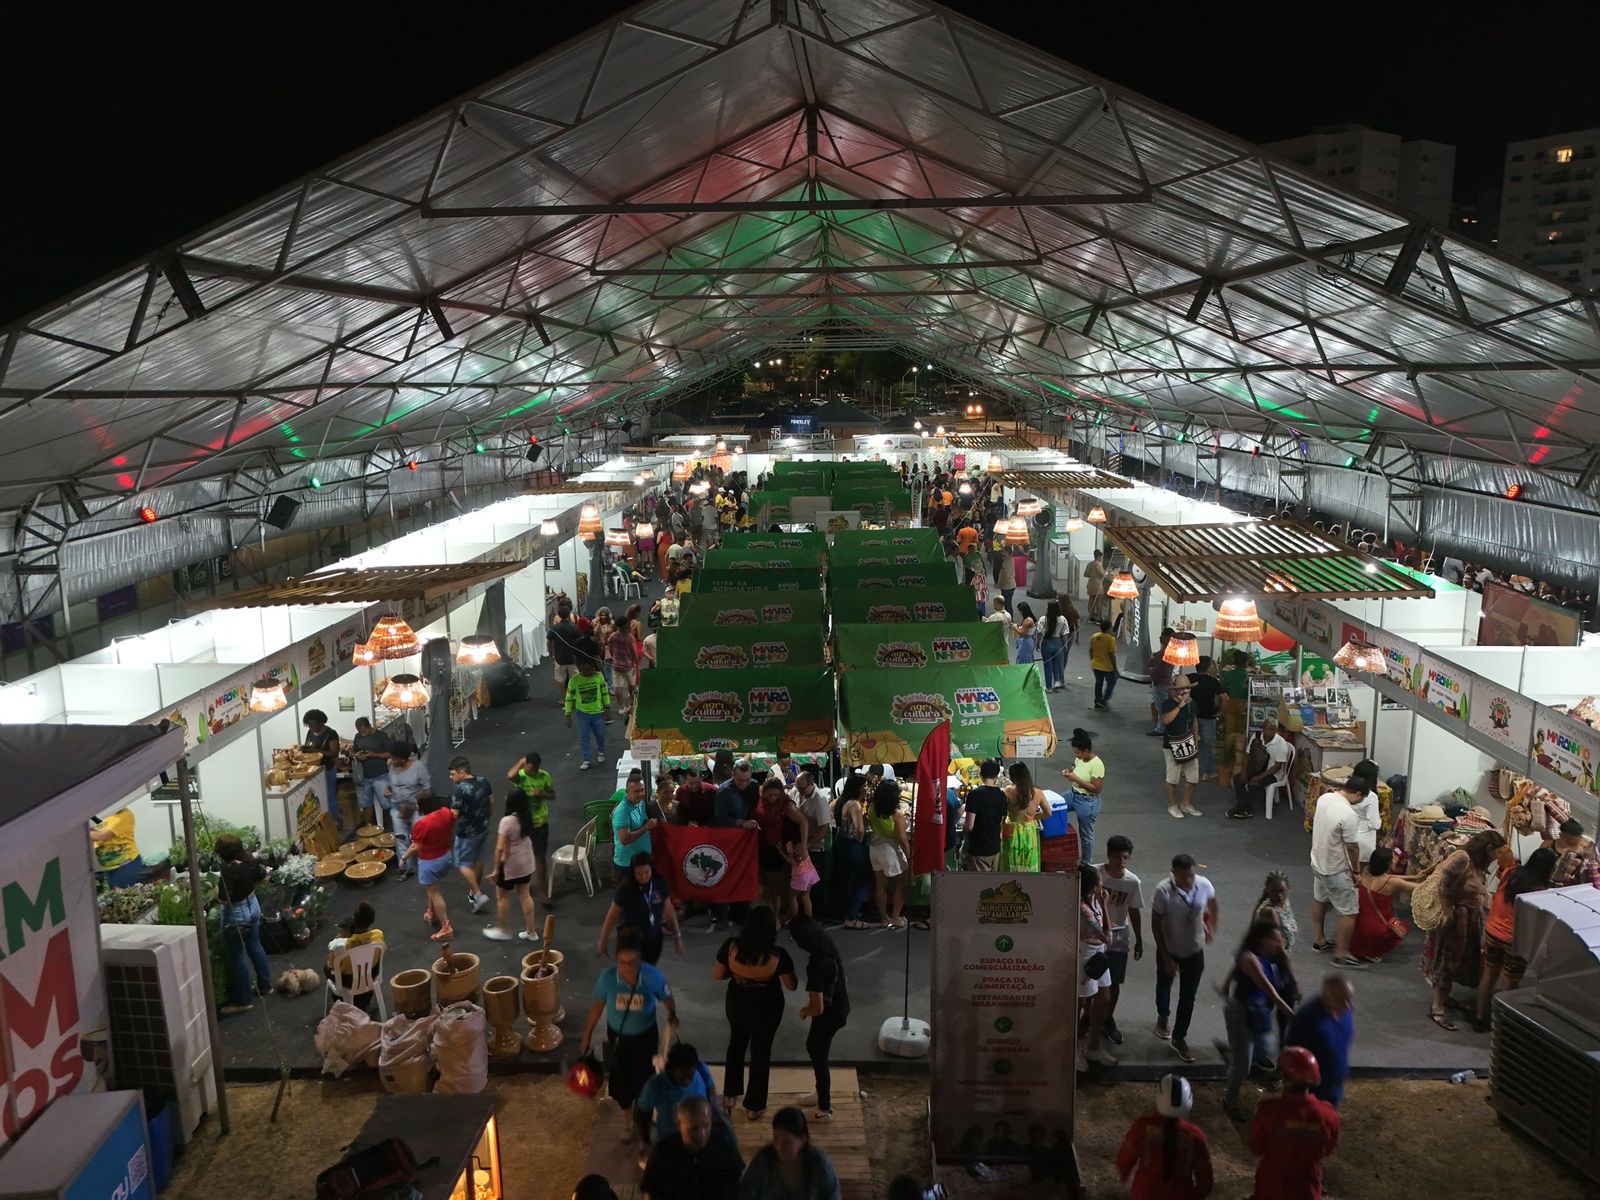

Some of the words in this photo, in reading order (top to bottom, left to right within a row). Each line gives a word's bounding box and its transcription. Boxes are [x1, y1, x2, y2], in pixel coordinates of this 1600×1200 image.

[752, 645, 788, 655] MARA
[933, 640, 970, 651] MARA
[750, 691, 791, 702] MARA
[956, 691, 999, 704] MARA
[695, 708, 731, 716] cultura
[903, 710, 941, 718] cultura
[961, 718, 983, 726] SAF
[0, 856, 66, 961] M
[964, 964, 1045, 972] COMERCIALIZAÇÃO
[974, 983, 1034, 991] ALIMENTAÇÃO
